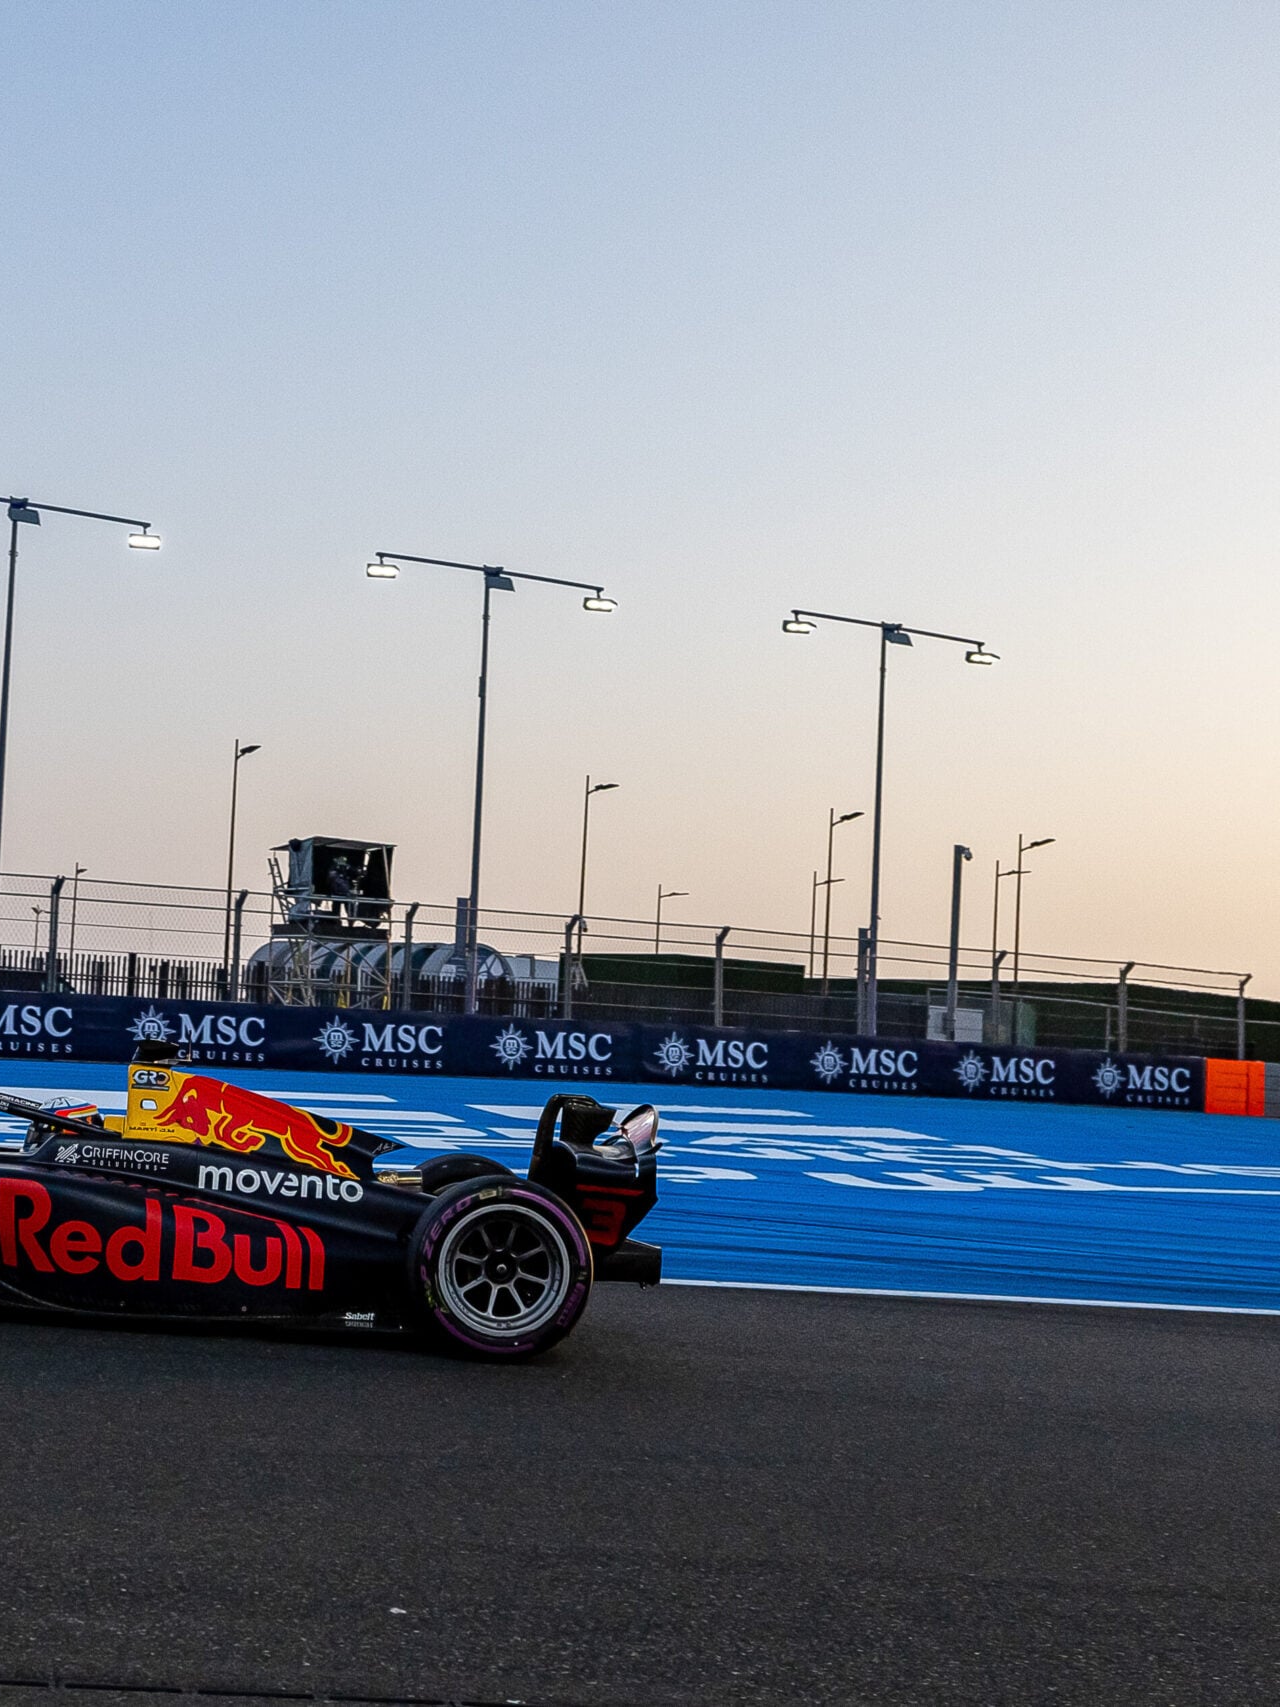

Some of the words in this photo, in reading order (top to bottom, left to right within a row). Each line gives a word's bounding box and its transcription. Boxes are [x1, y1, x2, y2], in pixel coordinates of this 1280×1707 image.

[177, 1014, 265, 1046] MSC
[361, 1024, 442, 1054] MSC
[177, 1050, 263, 1062] CRUISES
[534, 1031, 611, 1061] MSC
[696, 1039, 767, 1068] MSC
[361, 1058, 442, 1069] CRUISES
[534, 1065, 611, 1075] CRUISES
[849, 1048, 917, 1077] MSC
[990, 1057, 1054, 1084] MSC
[696, 1072, 767, 1082] CRUISES
[849, 1079, 916, 1089] CRUISES
[1127, 1065, 1189, 1092] MSC
[82, 1145, 170, 1164] GRIFFINCORE
[92, 1160, 158, 1171] SOLUTIONS
[198, 1165, 364, 1202] movento
[172, 1204, 325, 1291] Bull
